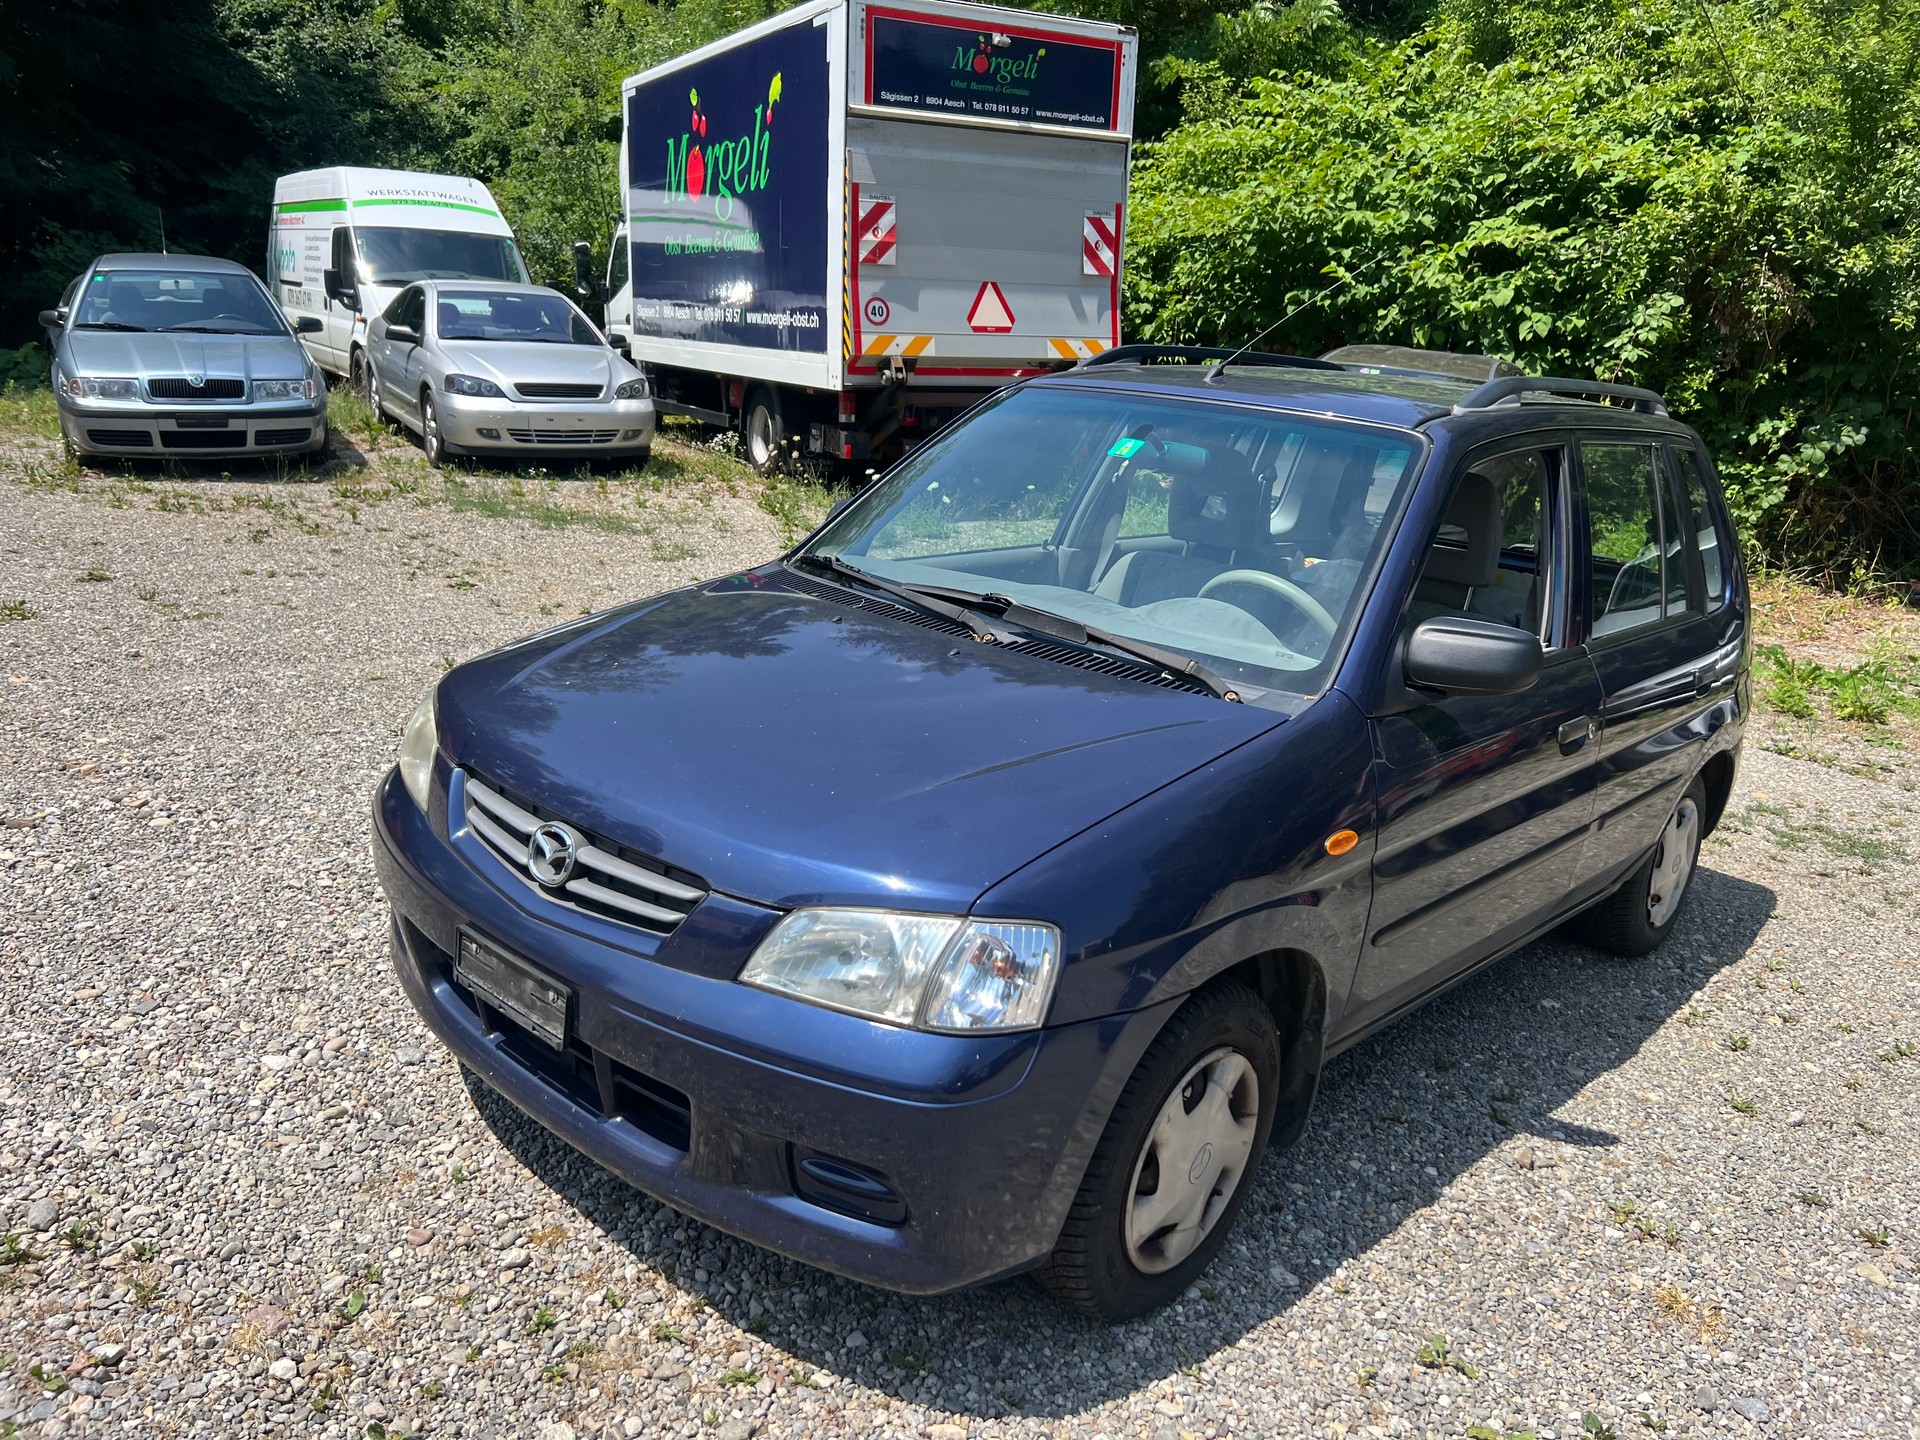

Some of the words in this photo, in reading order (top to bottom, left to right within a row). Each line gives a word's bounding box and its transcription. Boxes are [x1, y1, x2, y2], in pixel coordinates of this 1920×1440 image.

[951, 79, 967, 89] Obst
[970, 81, 994, 92] Beeren
[995, 85, 1002, 93] &
[1003, 86, 1030, 96] Gemüse
[880, 91, 913, 103] Sägissen
[913, 95, 919, 103] 2
[926, 96, 943, 106] 8904
[944, 98, 965, 108] Aesch
[972, 101, 983, 111] Tel.
[984, 102, 997, 112] 078
[998, 104, 1010, 113] 911
[1011, 105, 1020, 114] 50
[1021, 106, 1029, 115] 57
[1036, 109, 1104, 123] www.moergeli-obst.ch
[367, 188, 478, 205] WERKSTATTWAGEN
[664, 235, 681, 256] Obst
[685, 233, 712, 254] Beeren
[714, 231, 722, 252] &
[723, 229, 760, 252] Gemüse
[636, 304, 655, 320] Sägissen
[655, 307, 660, 318] 2
[663, 307, 675, 319] 8904
[675, 308, 690, 320] Aesch
[695, 307, 703, 320] Tel.
[704, 308, 714, 321] 078
[714, 308, 725, 322] 911
[726, 308, 733, 322] 50
[733, 309, 741, 323] 57
[746, 311, 819, 328] www.moergeli-obst.ch
[871, 305, 884, 317] 40
